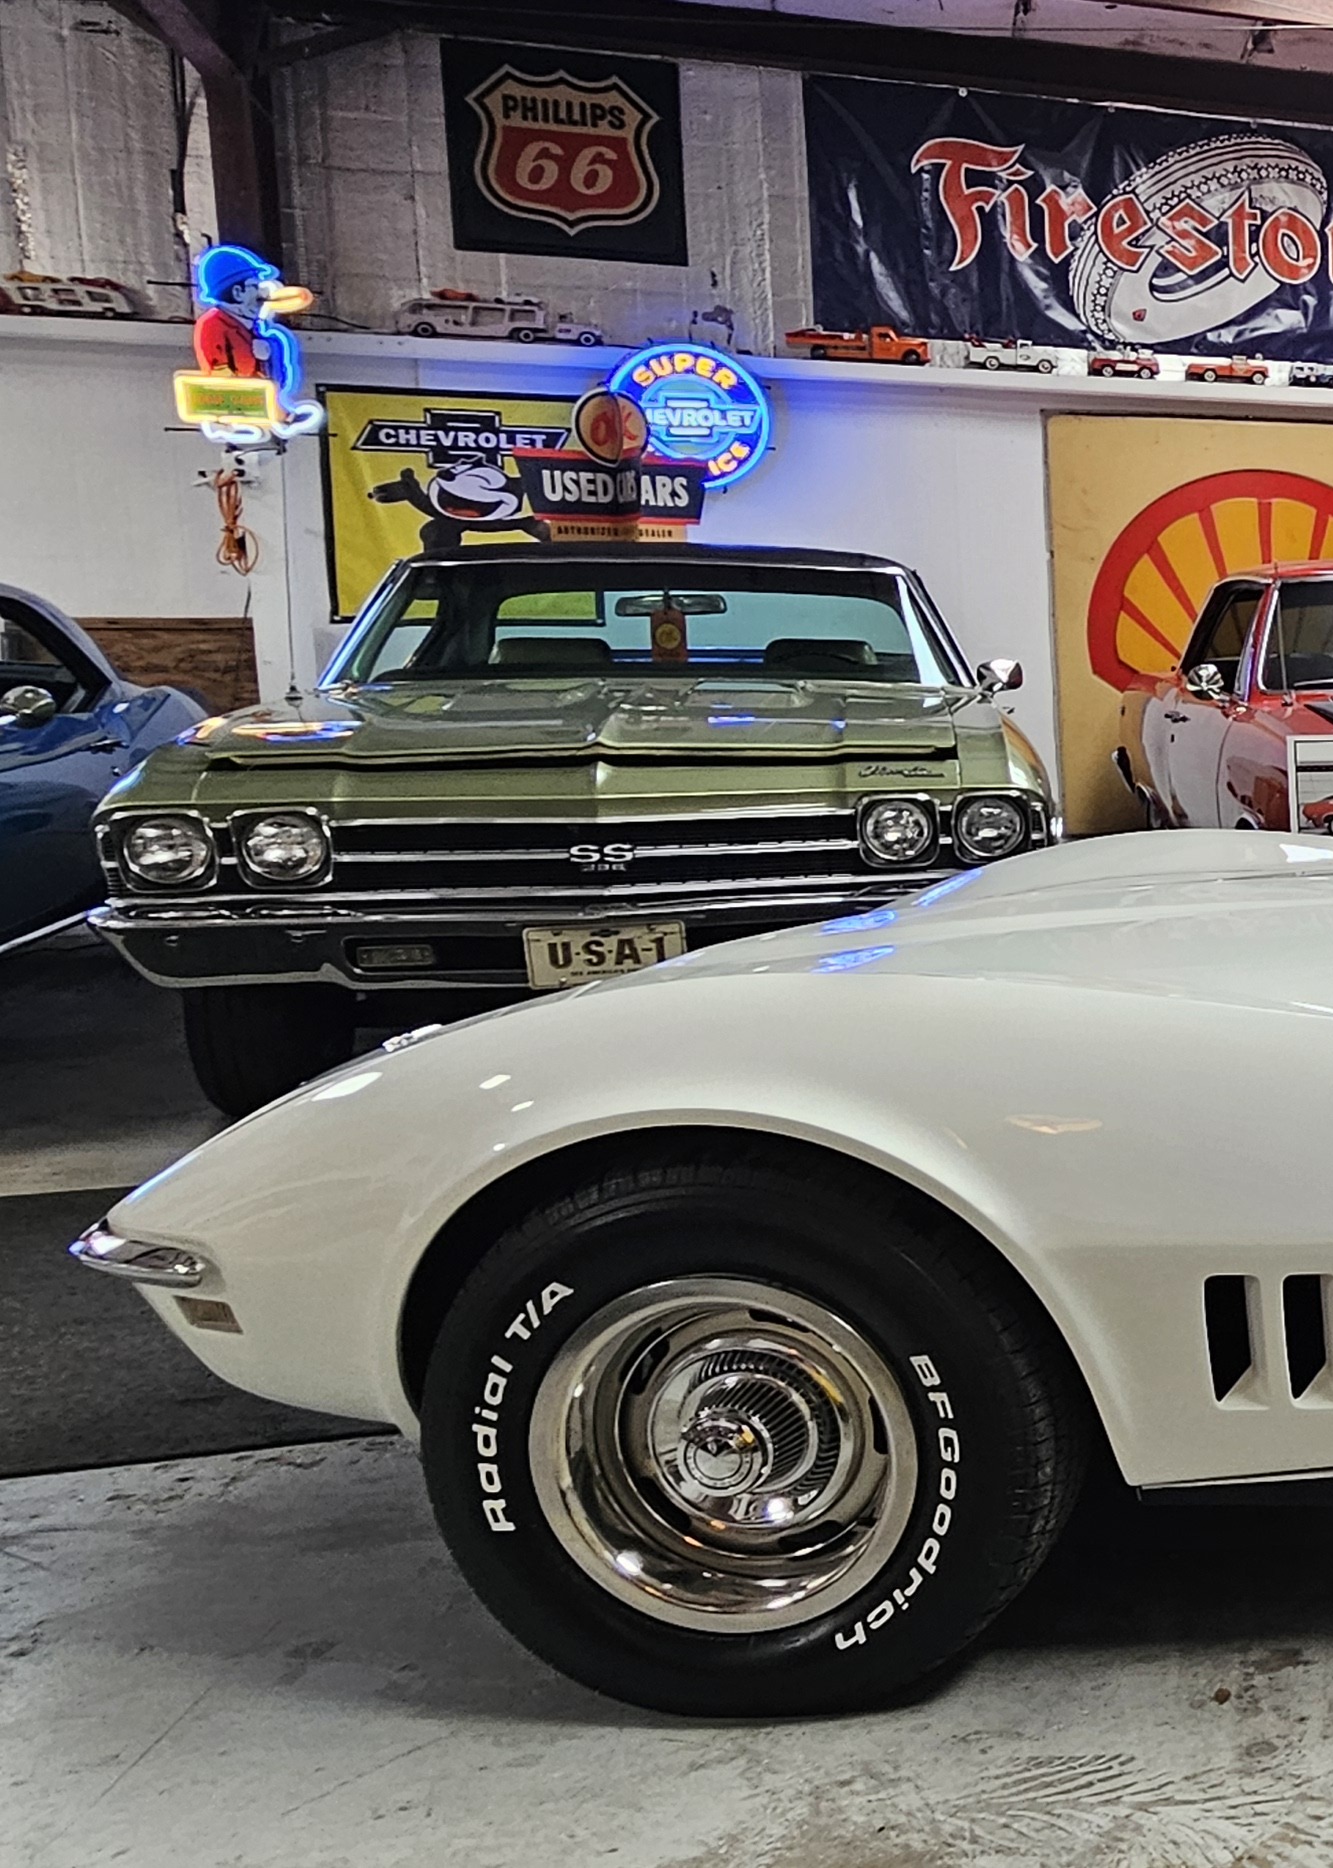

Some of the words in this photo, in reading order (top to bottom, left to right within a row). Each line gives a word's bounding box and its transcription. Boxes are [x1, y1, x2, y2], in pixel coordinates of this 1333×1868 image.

[501, 94, 627, 131] PHILLIPS
[515, 138, 619, 195] 66
[632, 352, 739, 391] SUPER
[377, 427, 547, 450] CHEVROLET
[541, 468, 616, 503] USED
[569, 843, 634, 863] SS
[471, 1354, 516, 1533] Radial
[504, 1280, 575, 1342] T/A
[834, 1353, 961, 1651] BFGoodrich
